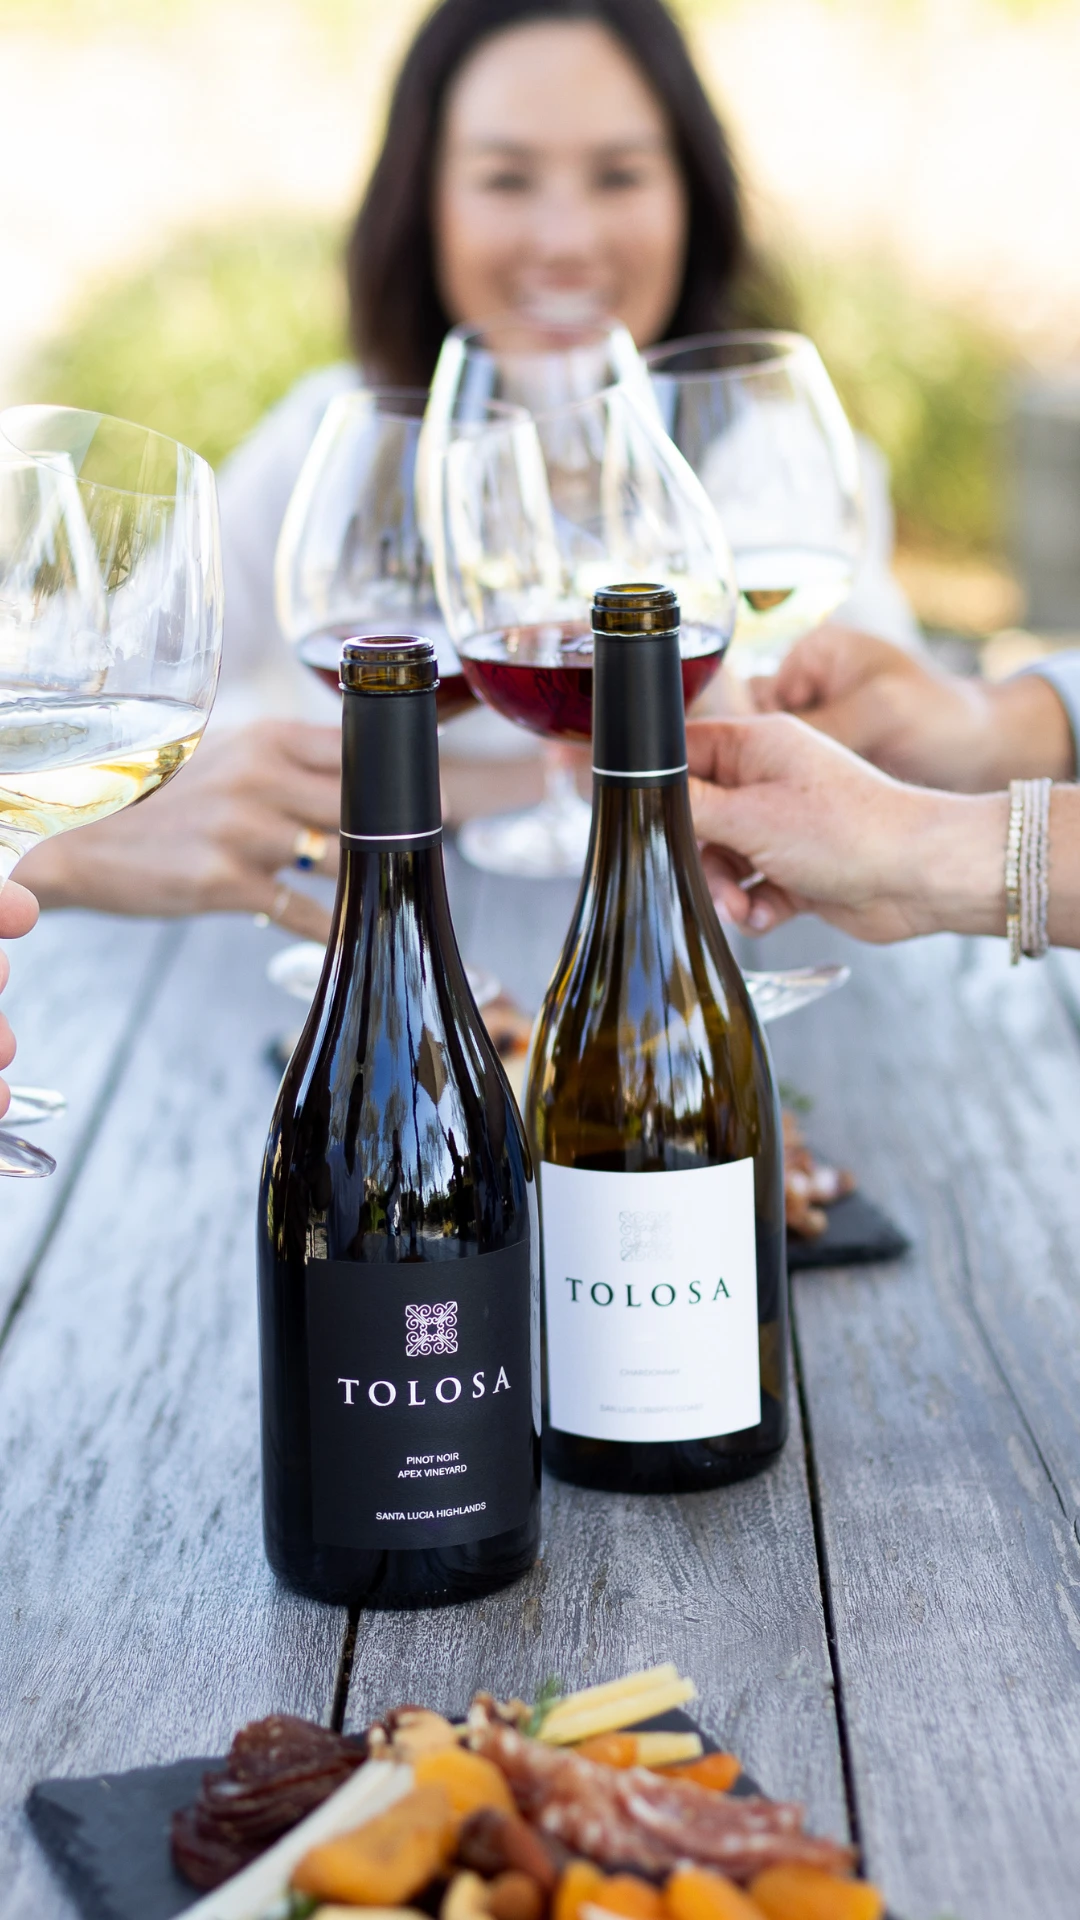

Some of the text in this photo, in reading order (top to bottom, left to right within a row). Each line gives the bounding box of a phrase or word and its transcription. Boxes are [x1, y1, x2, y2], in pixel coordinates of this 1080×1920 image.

[565, 1277, 731, 1307] TOLOSA
[338, 1366, 511, 1406] TOLOSA
[407, 1452, 459, 1464] PINOT NOIR
[398, 1463, 467, 1478] APEX VINEYARD
[376, 1502, 486, 1520] SANTA LUCIA HIGHLANDS
